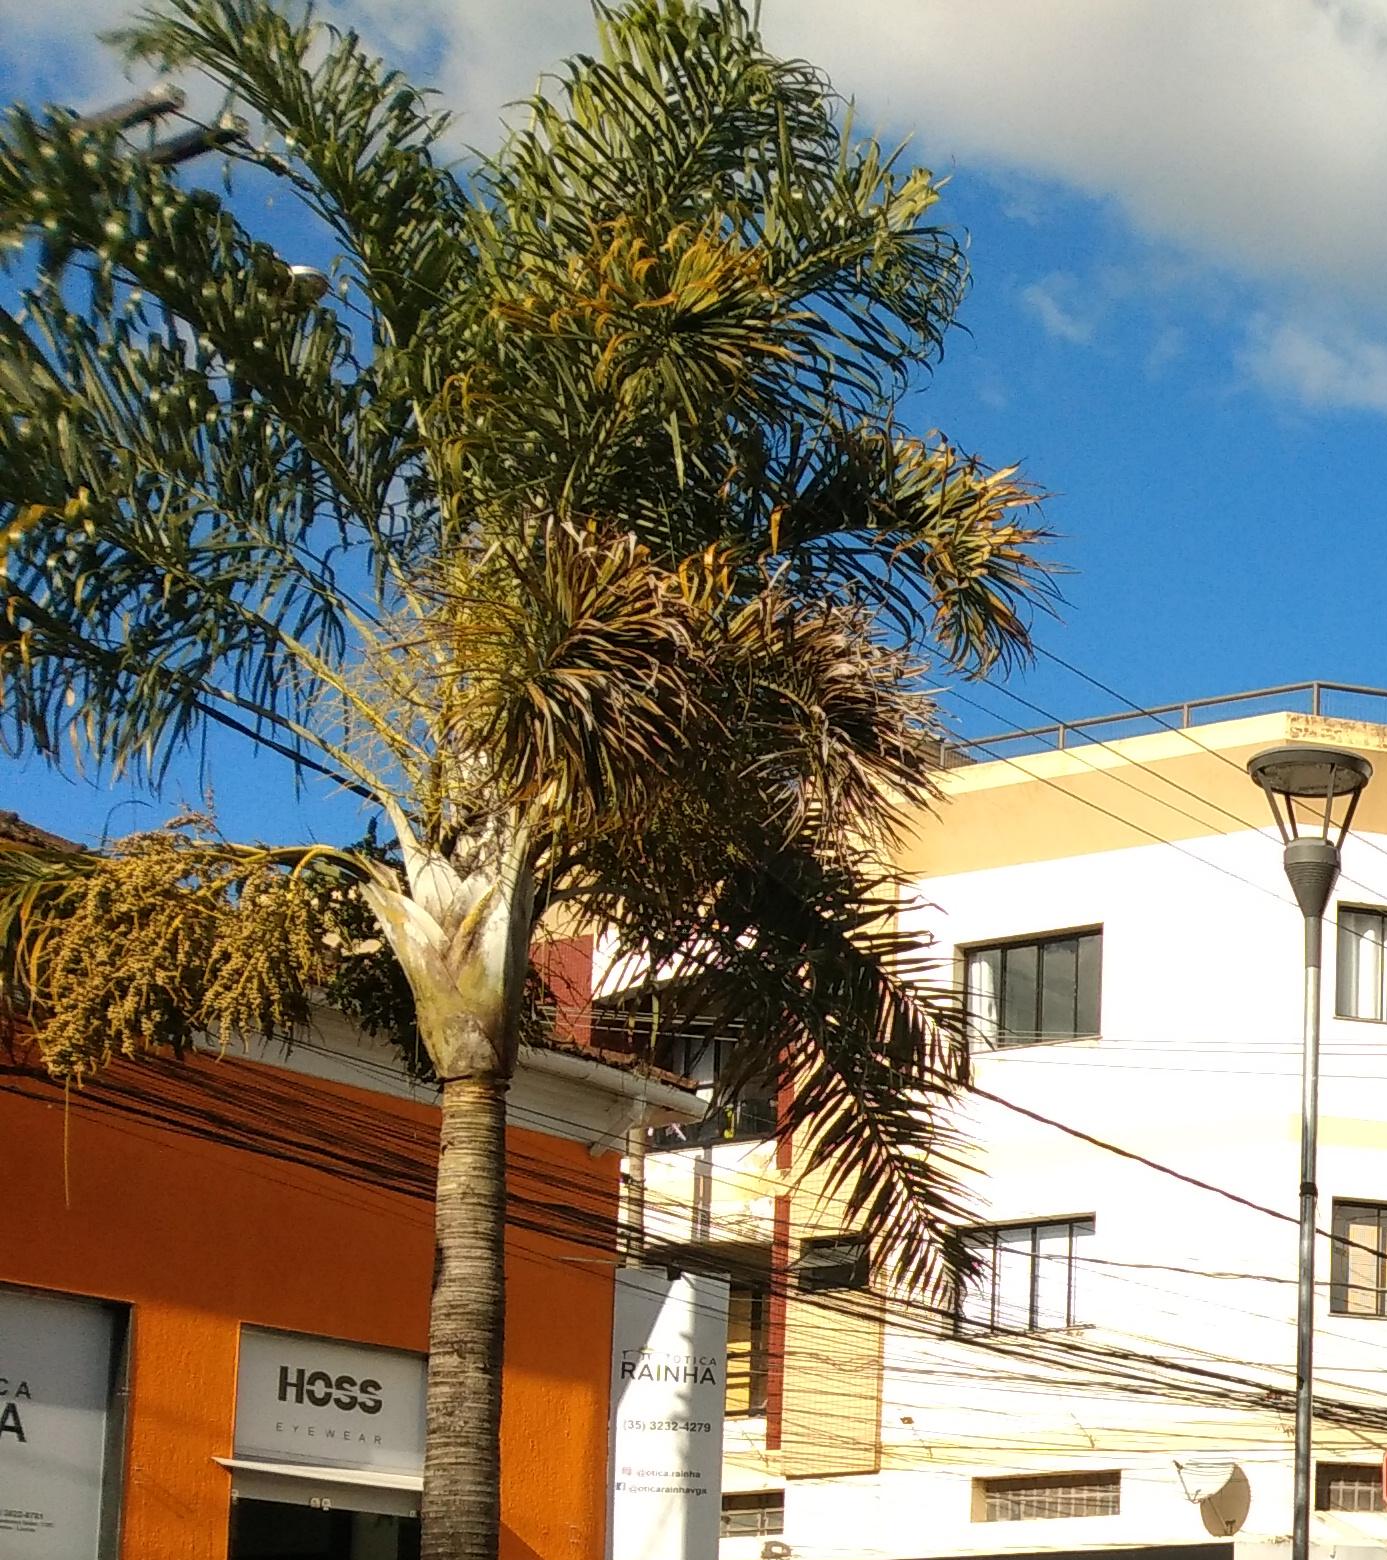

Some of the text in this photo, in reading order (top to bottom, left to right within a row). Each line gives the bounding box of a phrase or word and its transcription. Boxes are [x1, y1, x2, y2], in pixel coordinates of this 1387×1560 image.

[621, 1362, 716, 1385] RAINHA
[278, 1366, 382, 1414] HOSS
[276, 1422, 382, 1444] EYEWEAR
